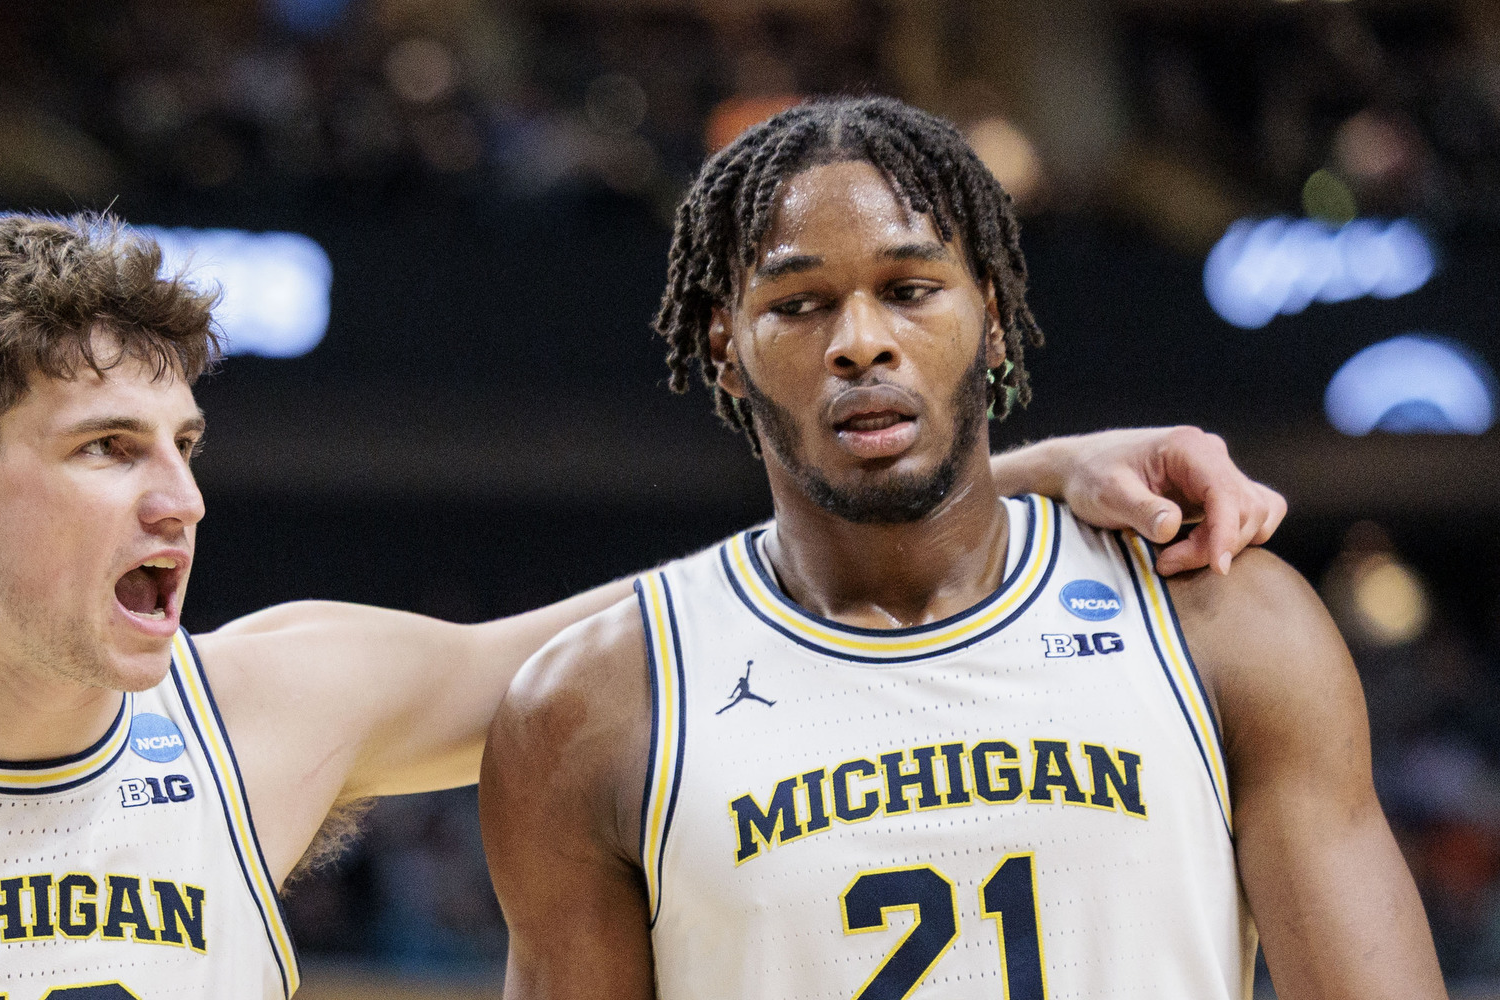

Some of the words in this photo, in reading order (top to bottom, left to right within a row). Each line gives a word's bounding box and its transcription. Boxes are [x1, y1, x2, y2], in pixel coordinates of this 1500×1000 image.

[1070, 598, 1121, 610] NCAA
[136, 734, 183, 751] NCAA
[729, 738, 1148, 867] MICHIGAN
